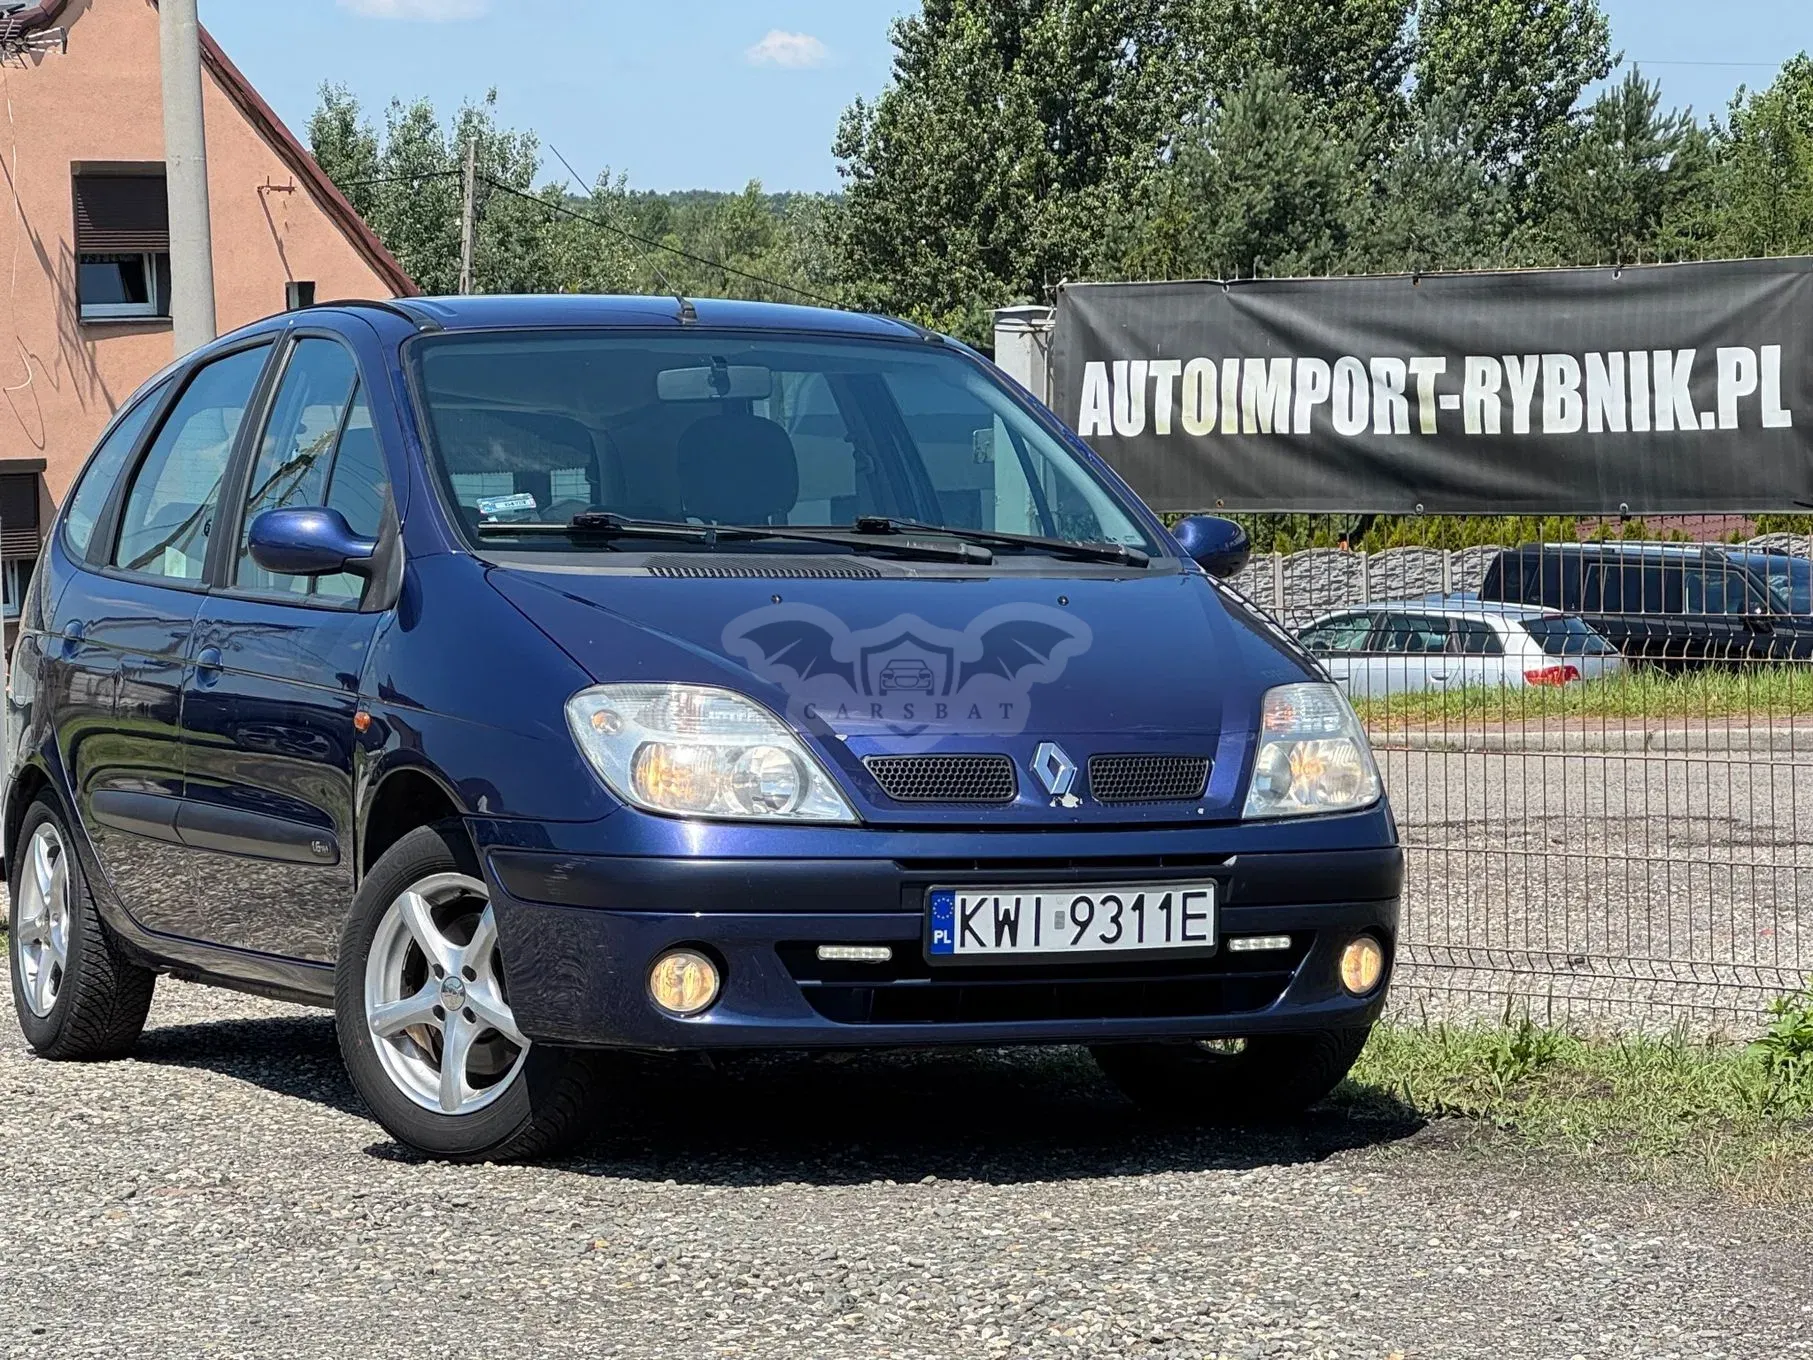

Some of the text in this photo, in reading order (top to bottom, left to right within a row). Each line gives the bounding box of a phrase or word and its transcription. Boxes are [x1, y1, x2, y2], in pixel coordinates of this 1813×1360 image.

[1078, 345, 1792, 436] AUTOIMPORT-RYBNIK.PL
[934, 931, 951, 944] PL
[959, 892, 1207, 948] KWI 9311E
